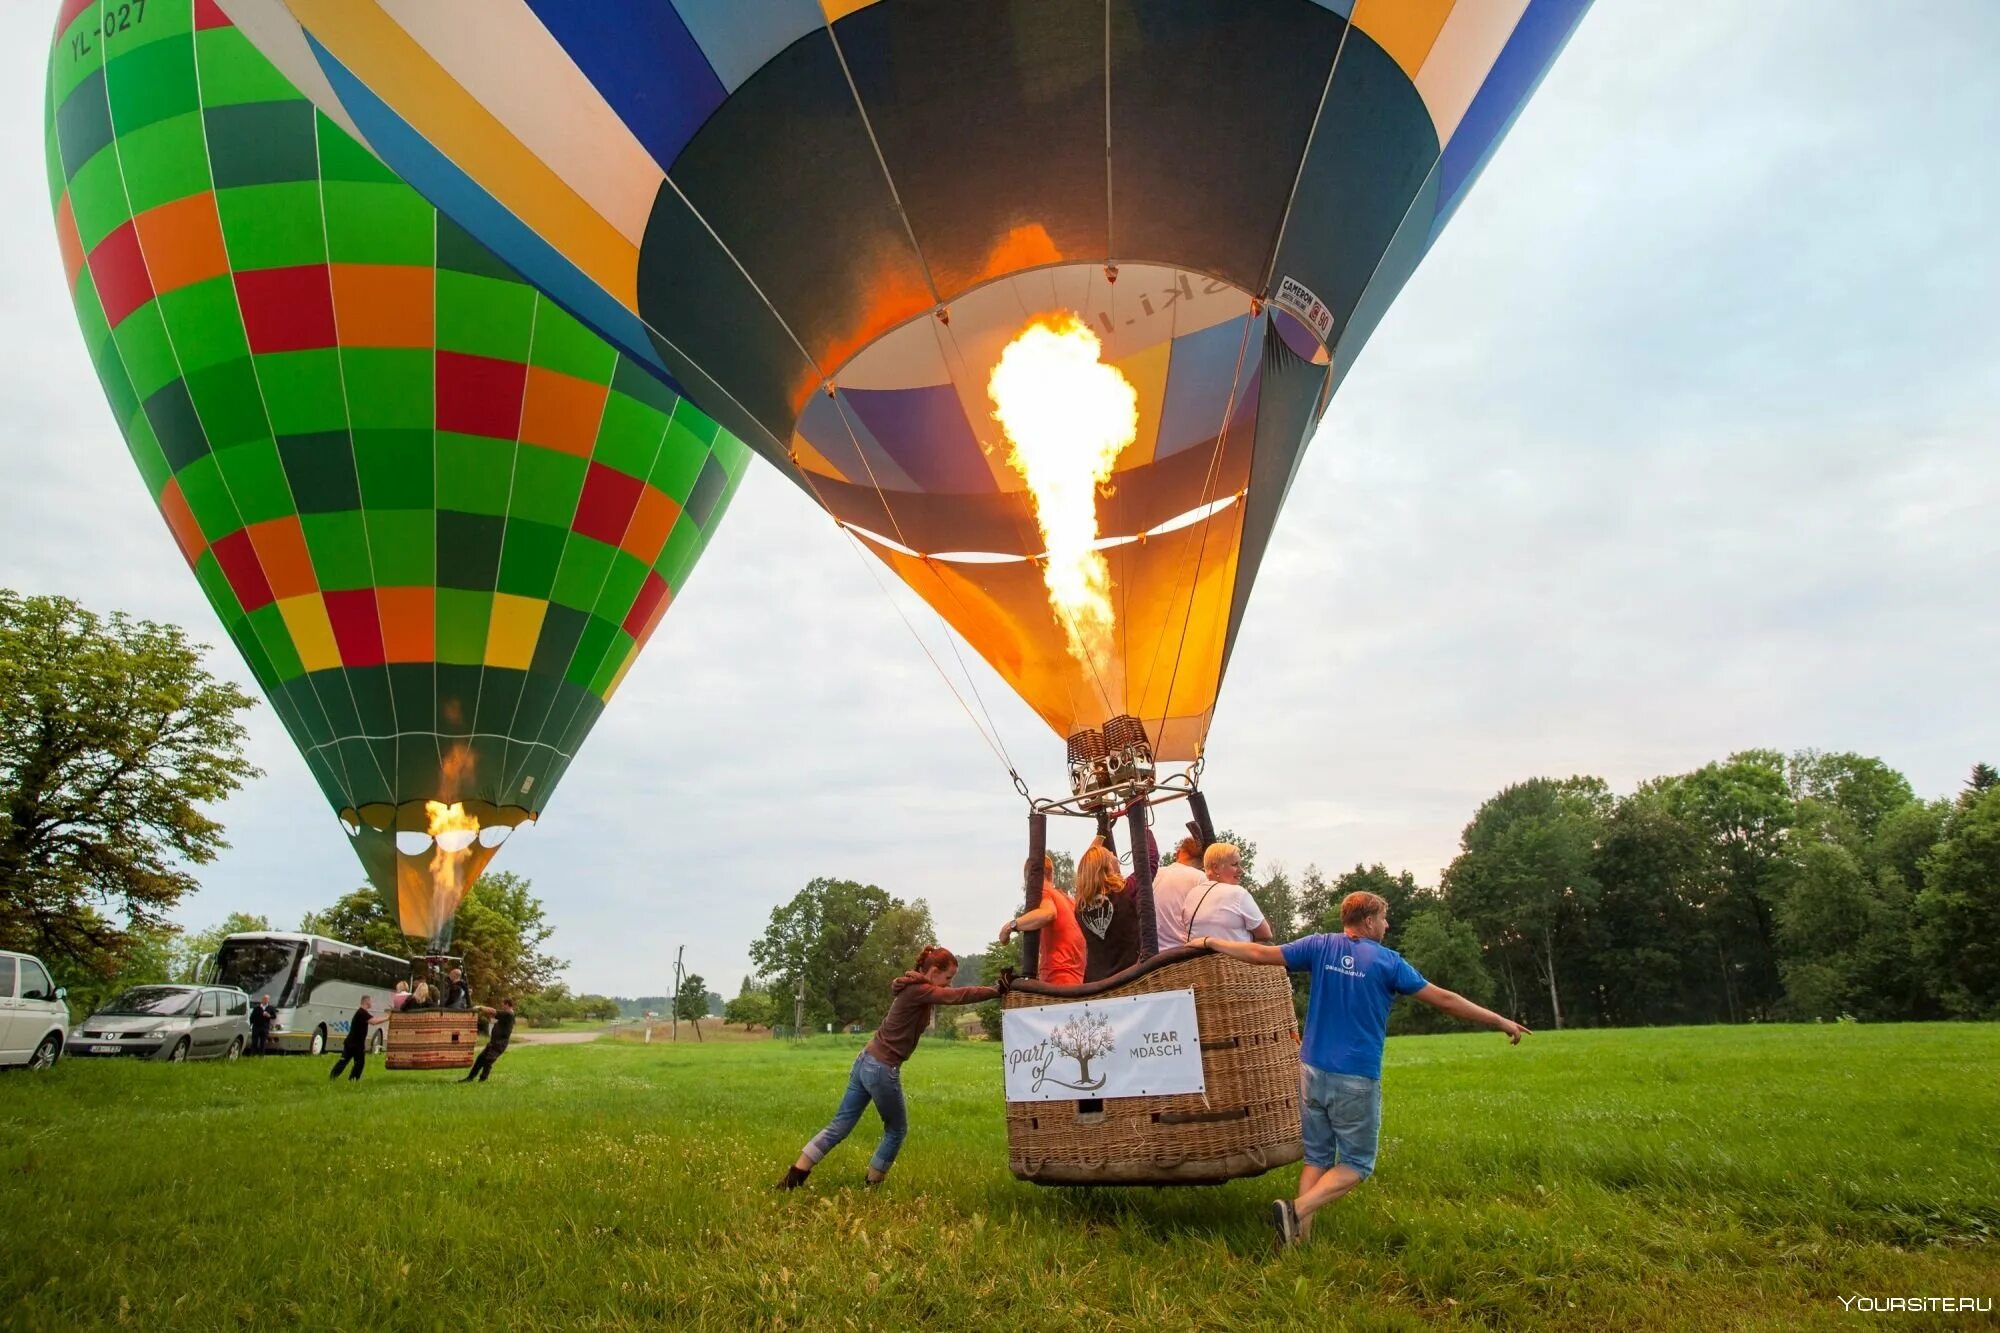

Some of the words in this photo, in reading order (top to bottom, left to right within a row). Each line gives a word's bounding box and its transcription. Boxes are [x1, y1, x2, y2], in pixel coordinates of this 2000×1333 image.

[1283, 280, 1314, 306] CAMERON
[1318, 311, 1329, 331] 90
[1143, 1031, 1178, 1044] YEAR
[1009, 1039, 1048, 1074] part
[1129, 1044, 1182, 1059] MDASCH
[1031, 1051, 1054, 1093] of
